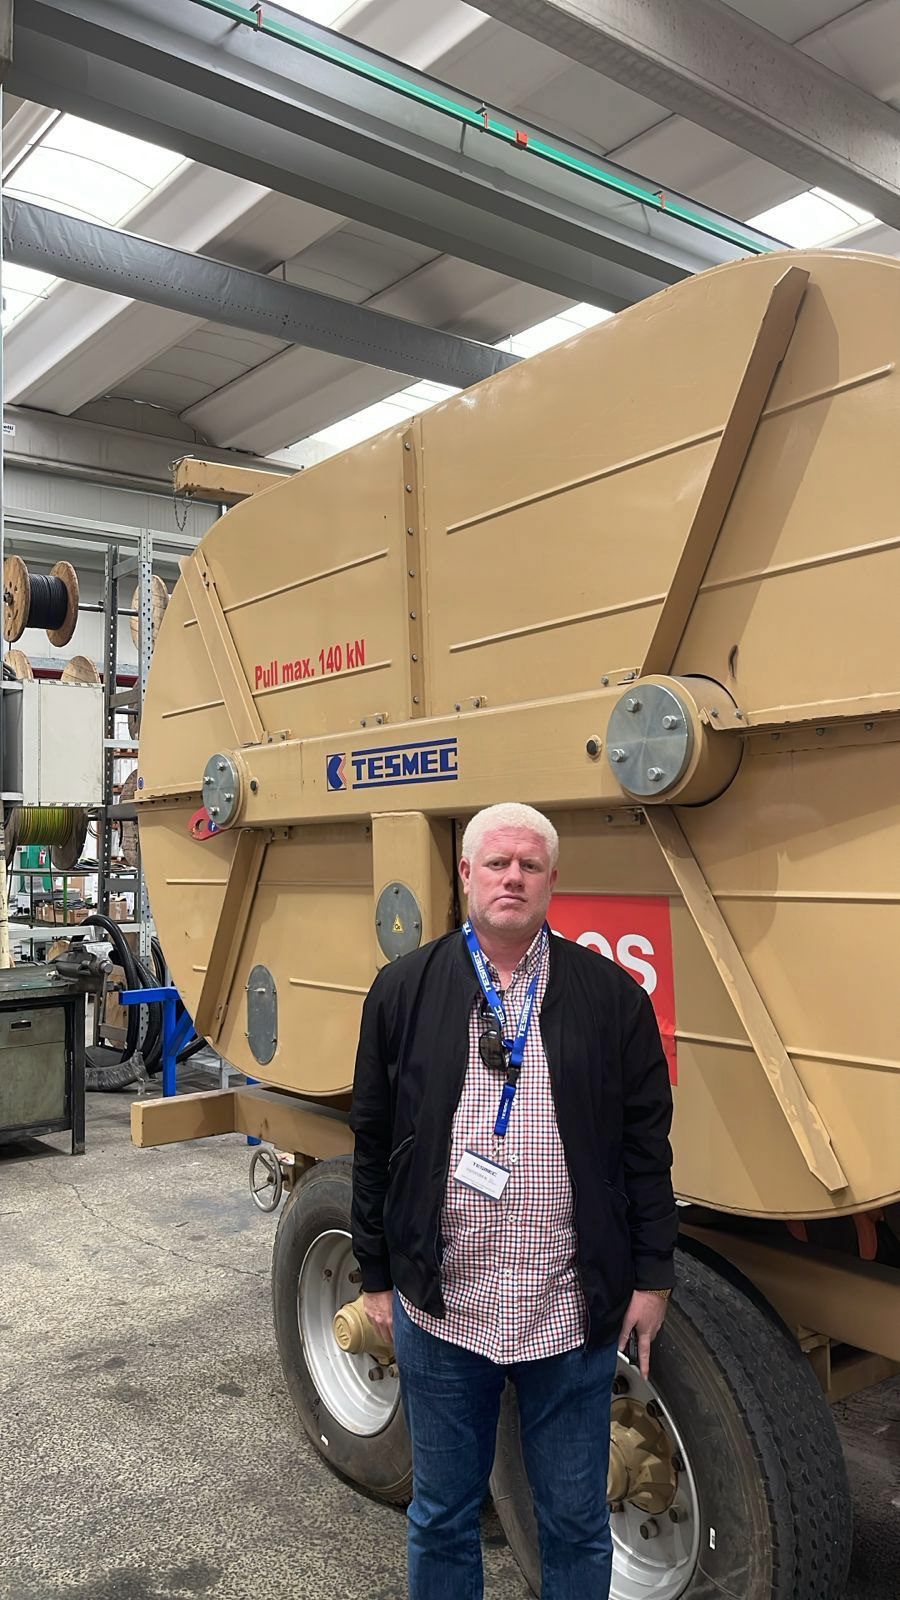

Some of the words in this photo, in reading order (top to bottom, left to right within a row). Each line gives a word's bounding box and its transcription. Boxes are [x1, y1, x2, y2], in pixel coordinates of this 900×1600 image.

[255, 661, 278, 690] Pull
[282, 657, 315, 684] max.
[318, 645, 342, 676] 140
[346, 639, 365, 667] kN
[351, 747, 458, 781] TESMEC
[472, 950, 492, 993] TESMEC
[517, 993, 533, 1038] TESMEC
